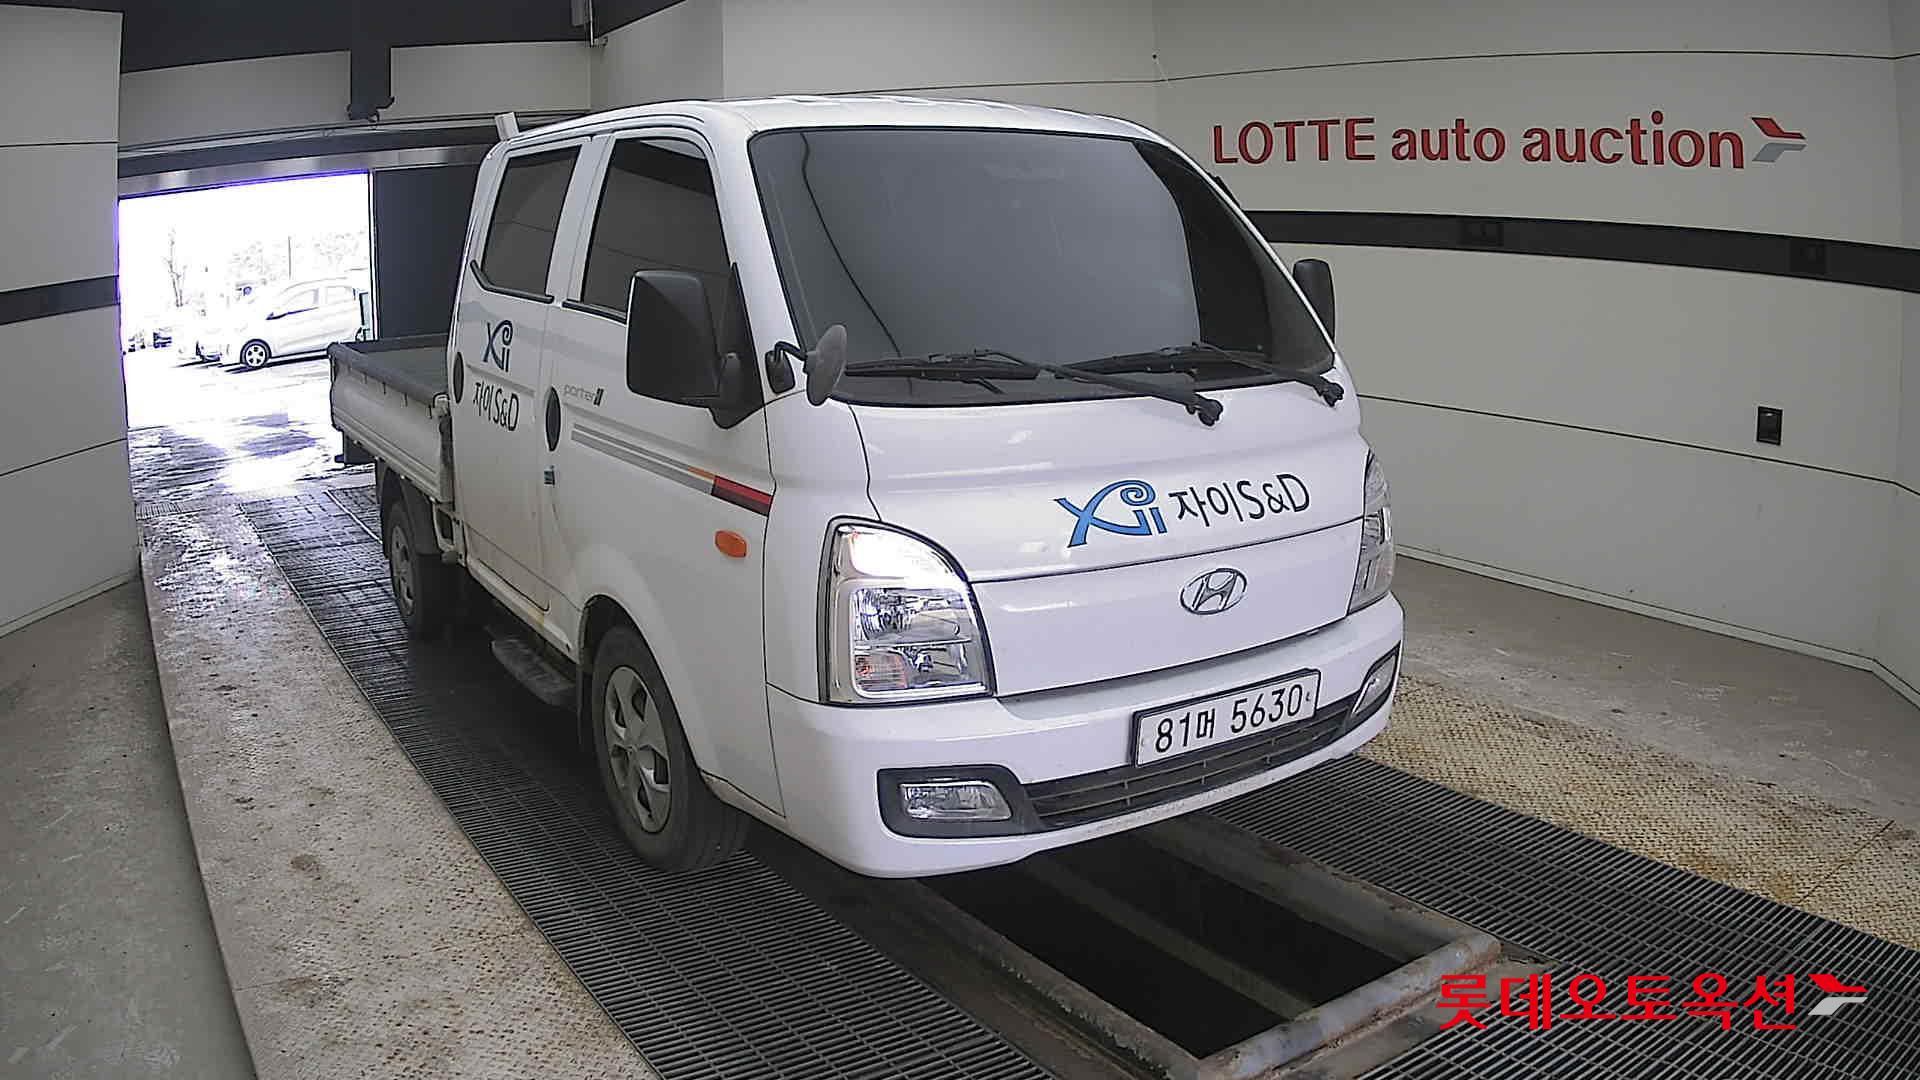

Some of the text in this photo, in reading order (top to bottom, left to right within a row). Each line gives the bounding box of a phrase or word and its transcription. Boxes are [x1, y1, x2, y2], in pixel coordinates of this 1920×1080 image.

[1212, 110, 1745, 169] LOTTE auto auction
[472, 381, 519, 431] 자이S&D
[1168, 473, 1310, 527] 자이S&D
[1155, 684, 1303, 753] 81머 5630
